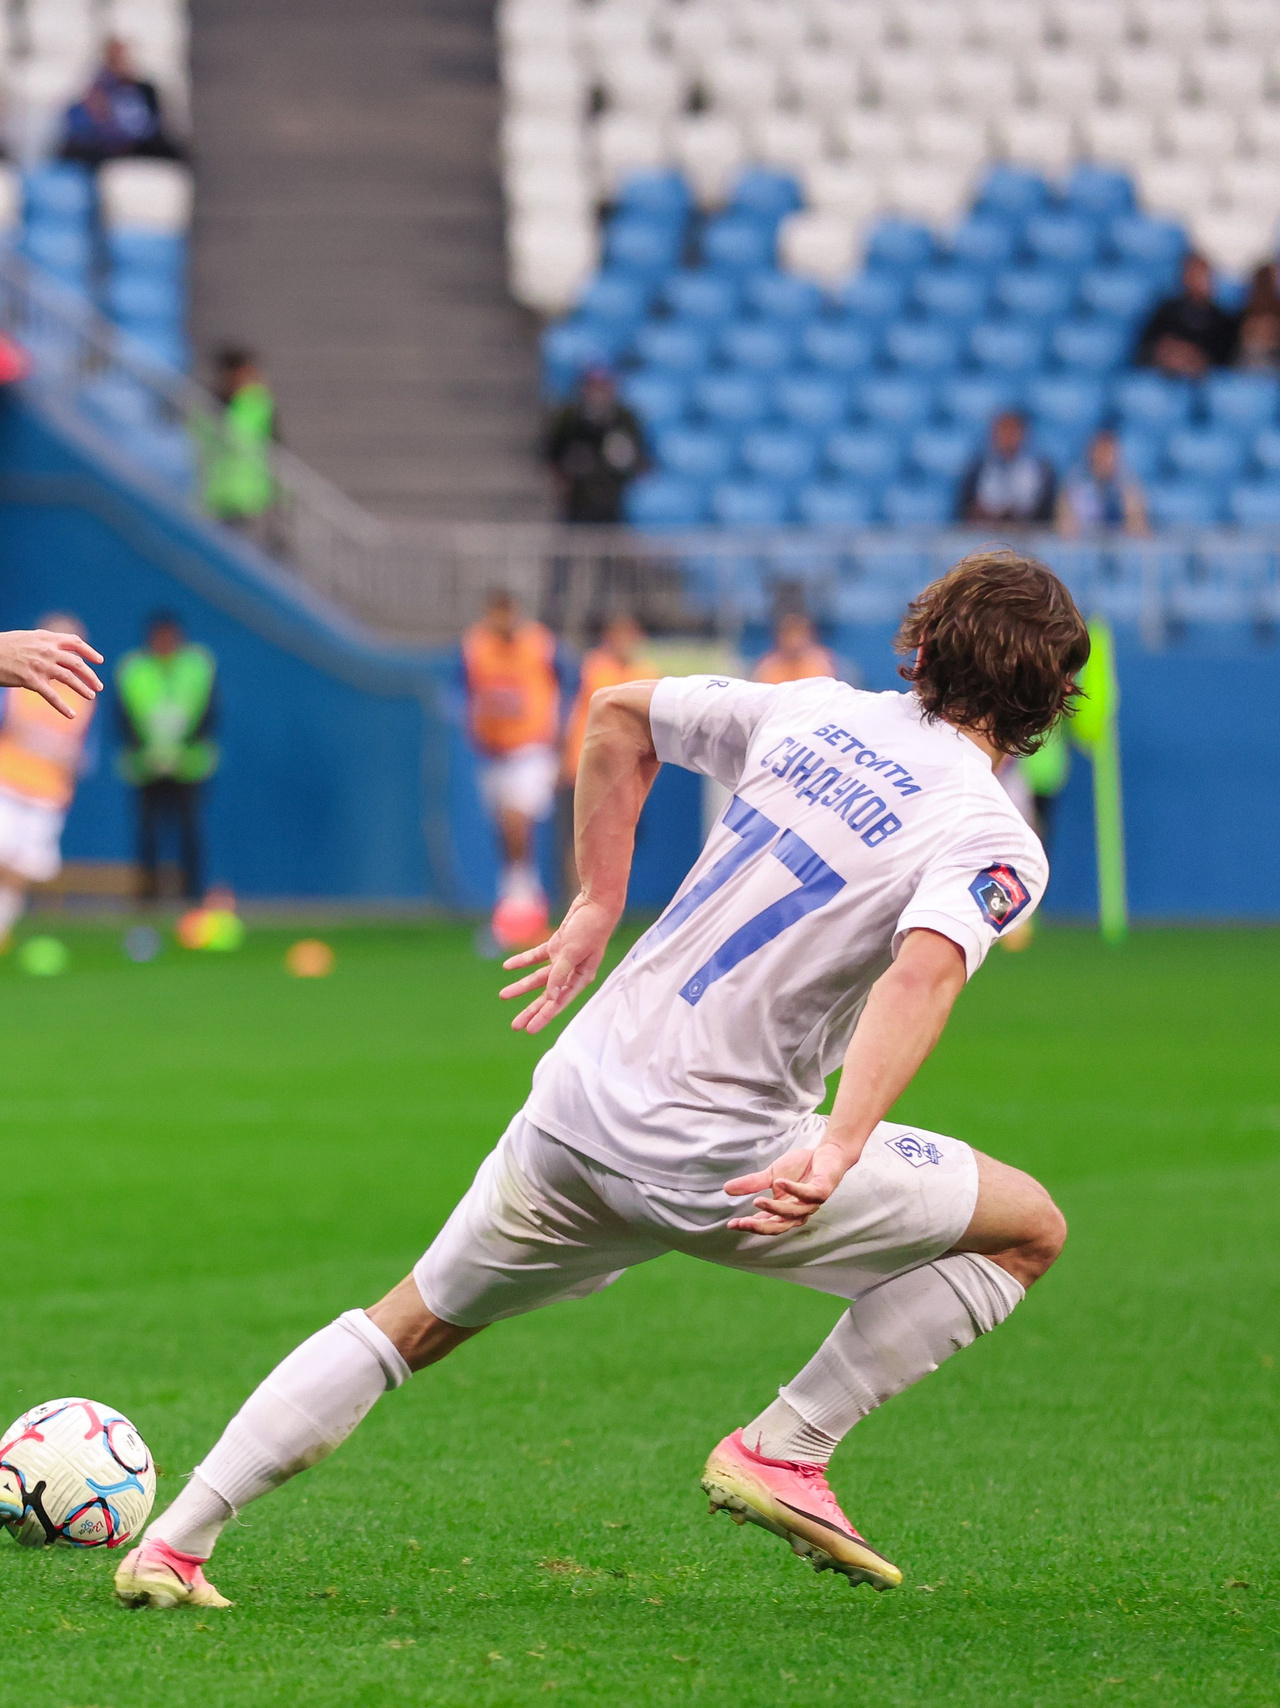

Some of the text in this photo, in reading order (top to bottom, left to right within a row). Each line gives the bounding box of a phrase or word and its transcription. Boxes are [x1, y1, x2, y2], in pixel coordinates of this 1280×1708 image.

[760, 736, 903, 848] СУНДУКОВ
[812, 723, 923, 797] БЕТСИТИ
[631, 794, 848, 1007] 77
